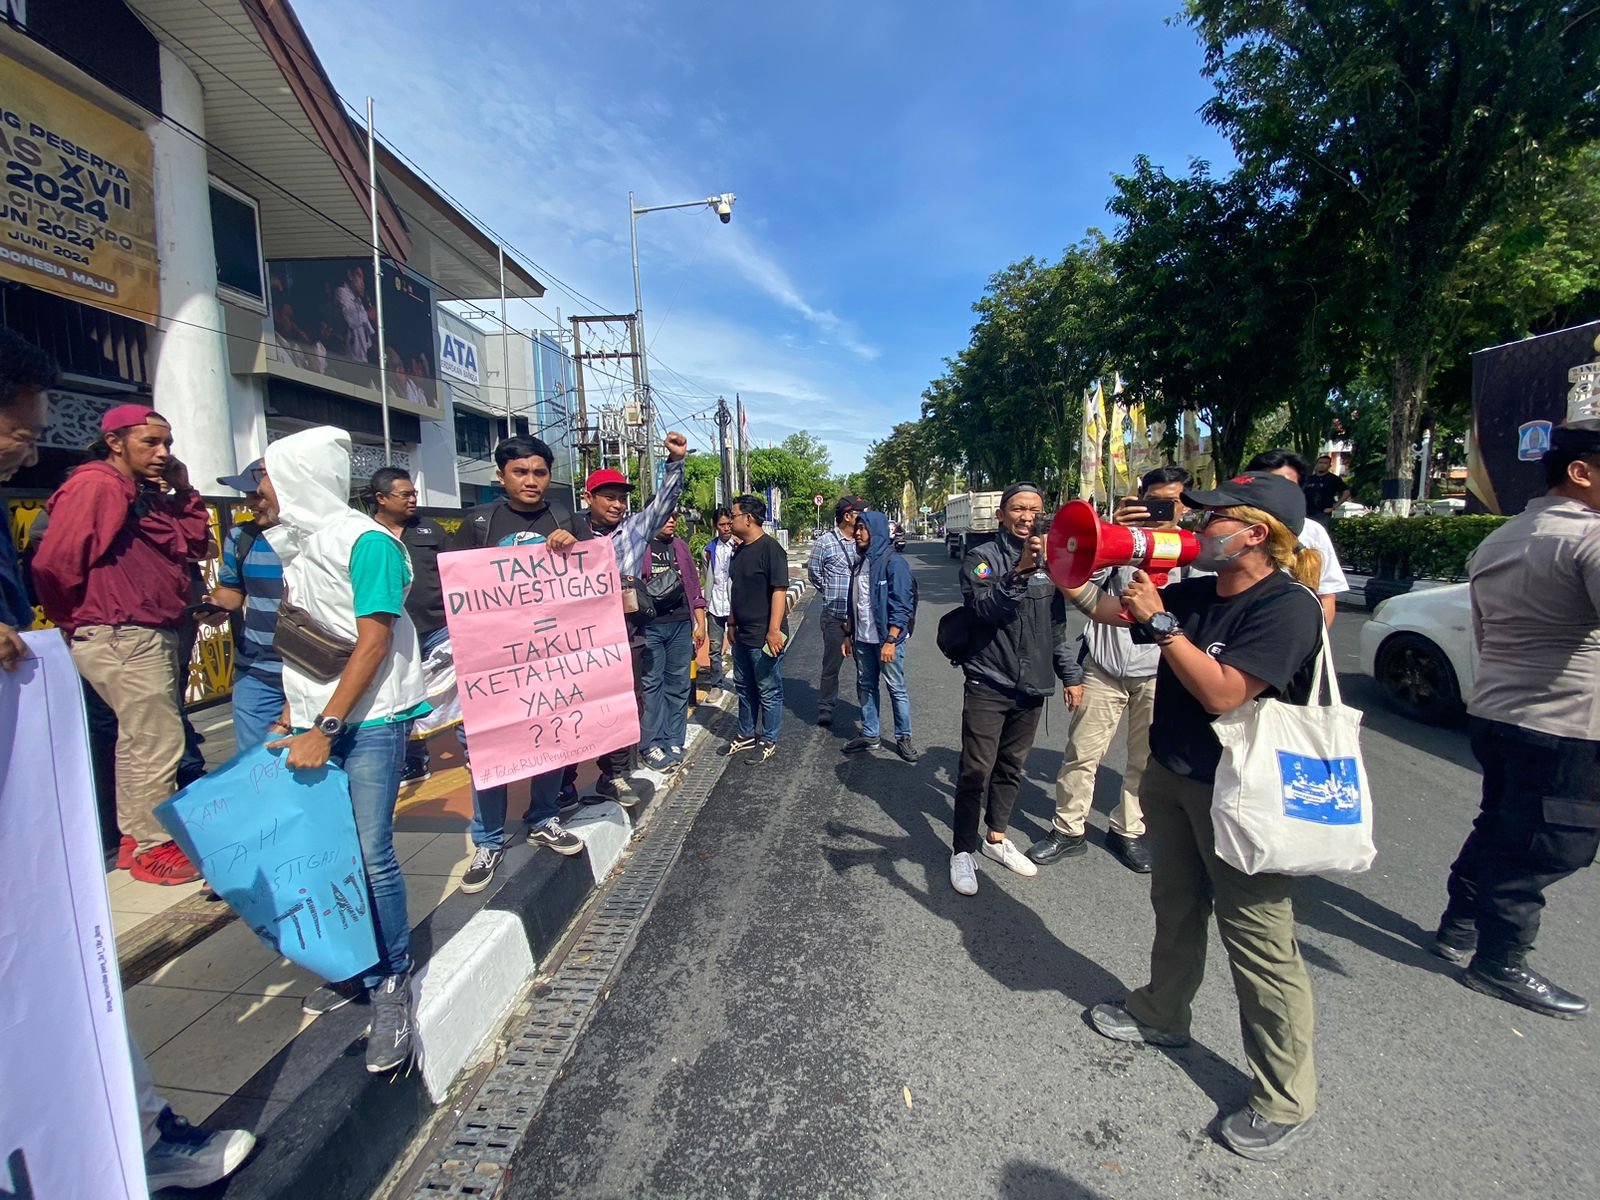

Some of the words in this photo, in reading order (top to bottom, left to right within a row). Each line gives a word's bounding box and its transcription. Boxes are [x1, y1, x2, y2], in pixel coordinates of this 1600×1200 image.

[0, 108, 21, 131] G
[29, 122, 130, 184] PESERTA
[5, 160, 109, 223] 2024
[58, 155, 131, 210] XVII
[8, 190, 66, 222] CITY
[75, 218, 133, 251] EXPO
[37, 218, 96, 251] 2024
[7, 230, 49, 251] JUNI
[53, 245, 91, 266] 2024
[72, 271, 116, 294] MAJU
[438, 333, 478, 373] ATA
[490, 550, 589, 582] TAKUT
[448, 571, 615, 615] DIINVESTIGASI
[502, 624, 598, 664] TAKUT
[464, 643, 623, 700] KETAHUAN
[519, 683, 585, 718] YAAA
